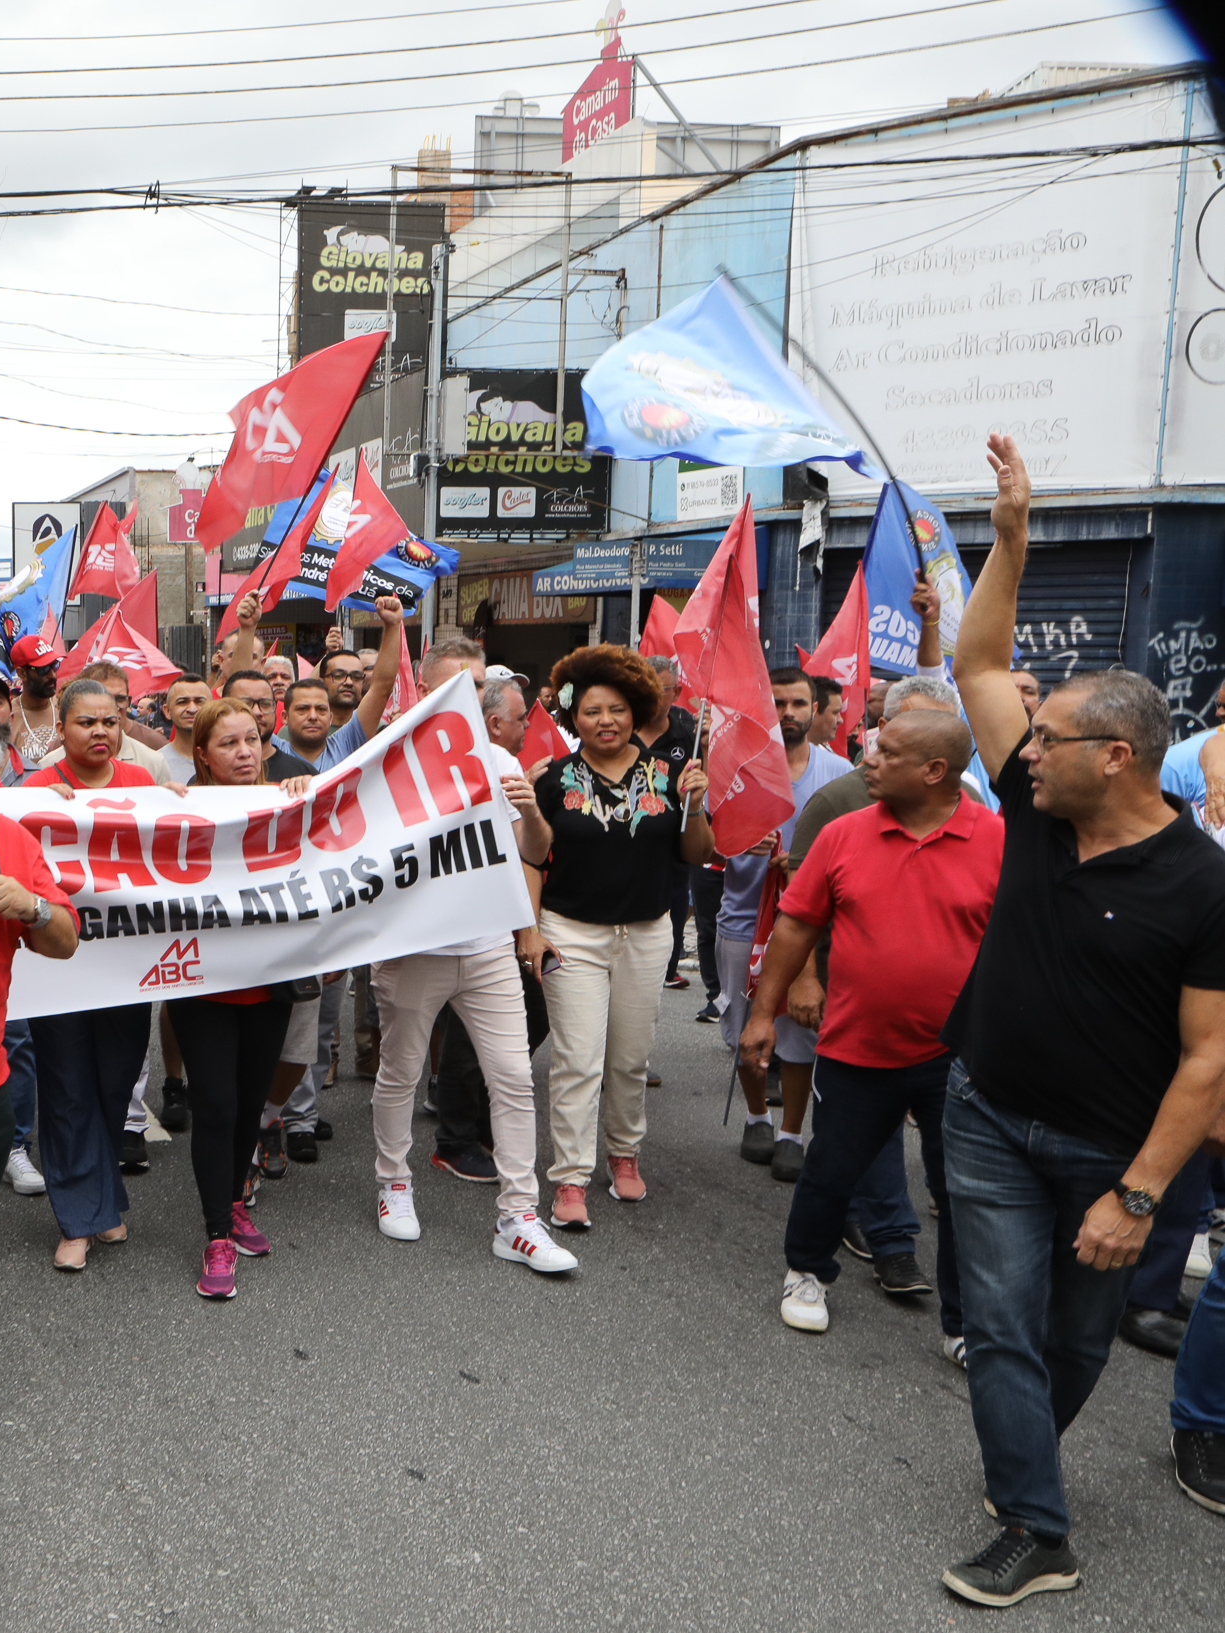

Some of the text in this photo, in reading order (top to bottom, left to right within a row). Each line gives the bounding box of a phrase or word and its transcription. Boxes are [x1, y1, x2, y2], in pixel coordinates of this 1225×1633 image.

[572, 77, 619, 126] Camarim
[572, 111, 615, 157] da Casa
[320, 246, 425, 269] Giovana
[871, 228, 1087, 279] Refrigeração
[312, 270, 431, 294] Colchões
[829, 273, 1133, 331] Máquina de Lavar
[829, 316, 1123, 373] Ar Condicionado
[884, 376, 1054, 411] Secadoras
[466, 414, 584, 443] Giovana
[446, 446, 592, 473] Colchões
[550, 504, 589, 512] COLCHÕES
[576, 546, 630, 559] Mal.Deodoro
[649, 543, 683, 556] P. Setti
[300, 567, 327, 582] ndré
[300, 552, 311, 563] os
[396, 585, 414, 600] de
[536, 572, 650, 592] AR CONDICIONAO
[358, 585, 378, 598] uá
[460, 578, 489, 605] SUPER
[491, 577, 529, 620] CAMA
[533, 596, 563, 619] BOX
[658, 588, 690, 599] ALUGA-S
[462, 605, 476, 623] OFE
[382, 711, 493, 828] IR
[19, 797, 216, 897] ÇÃO
[78, 818, 508, 942] GANHA ATÉ R$ 5 MIL
[138, 960, 204, 987] ABC
